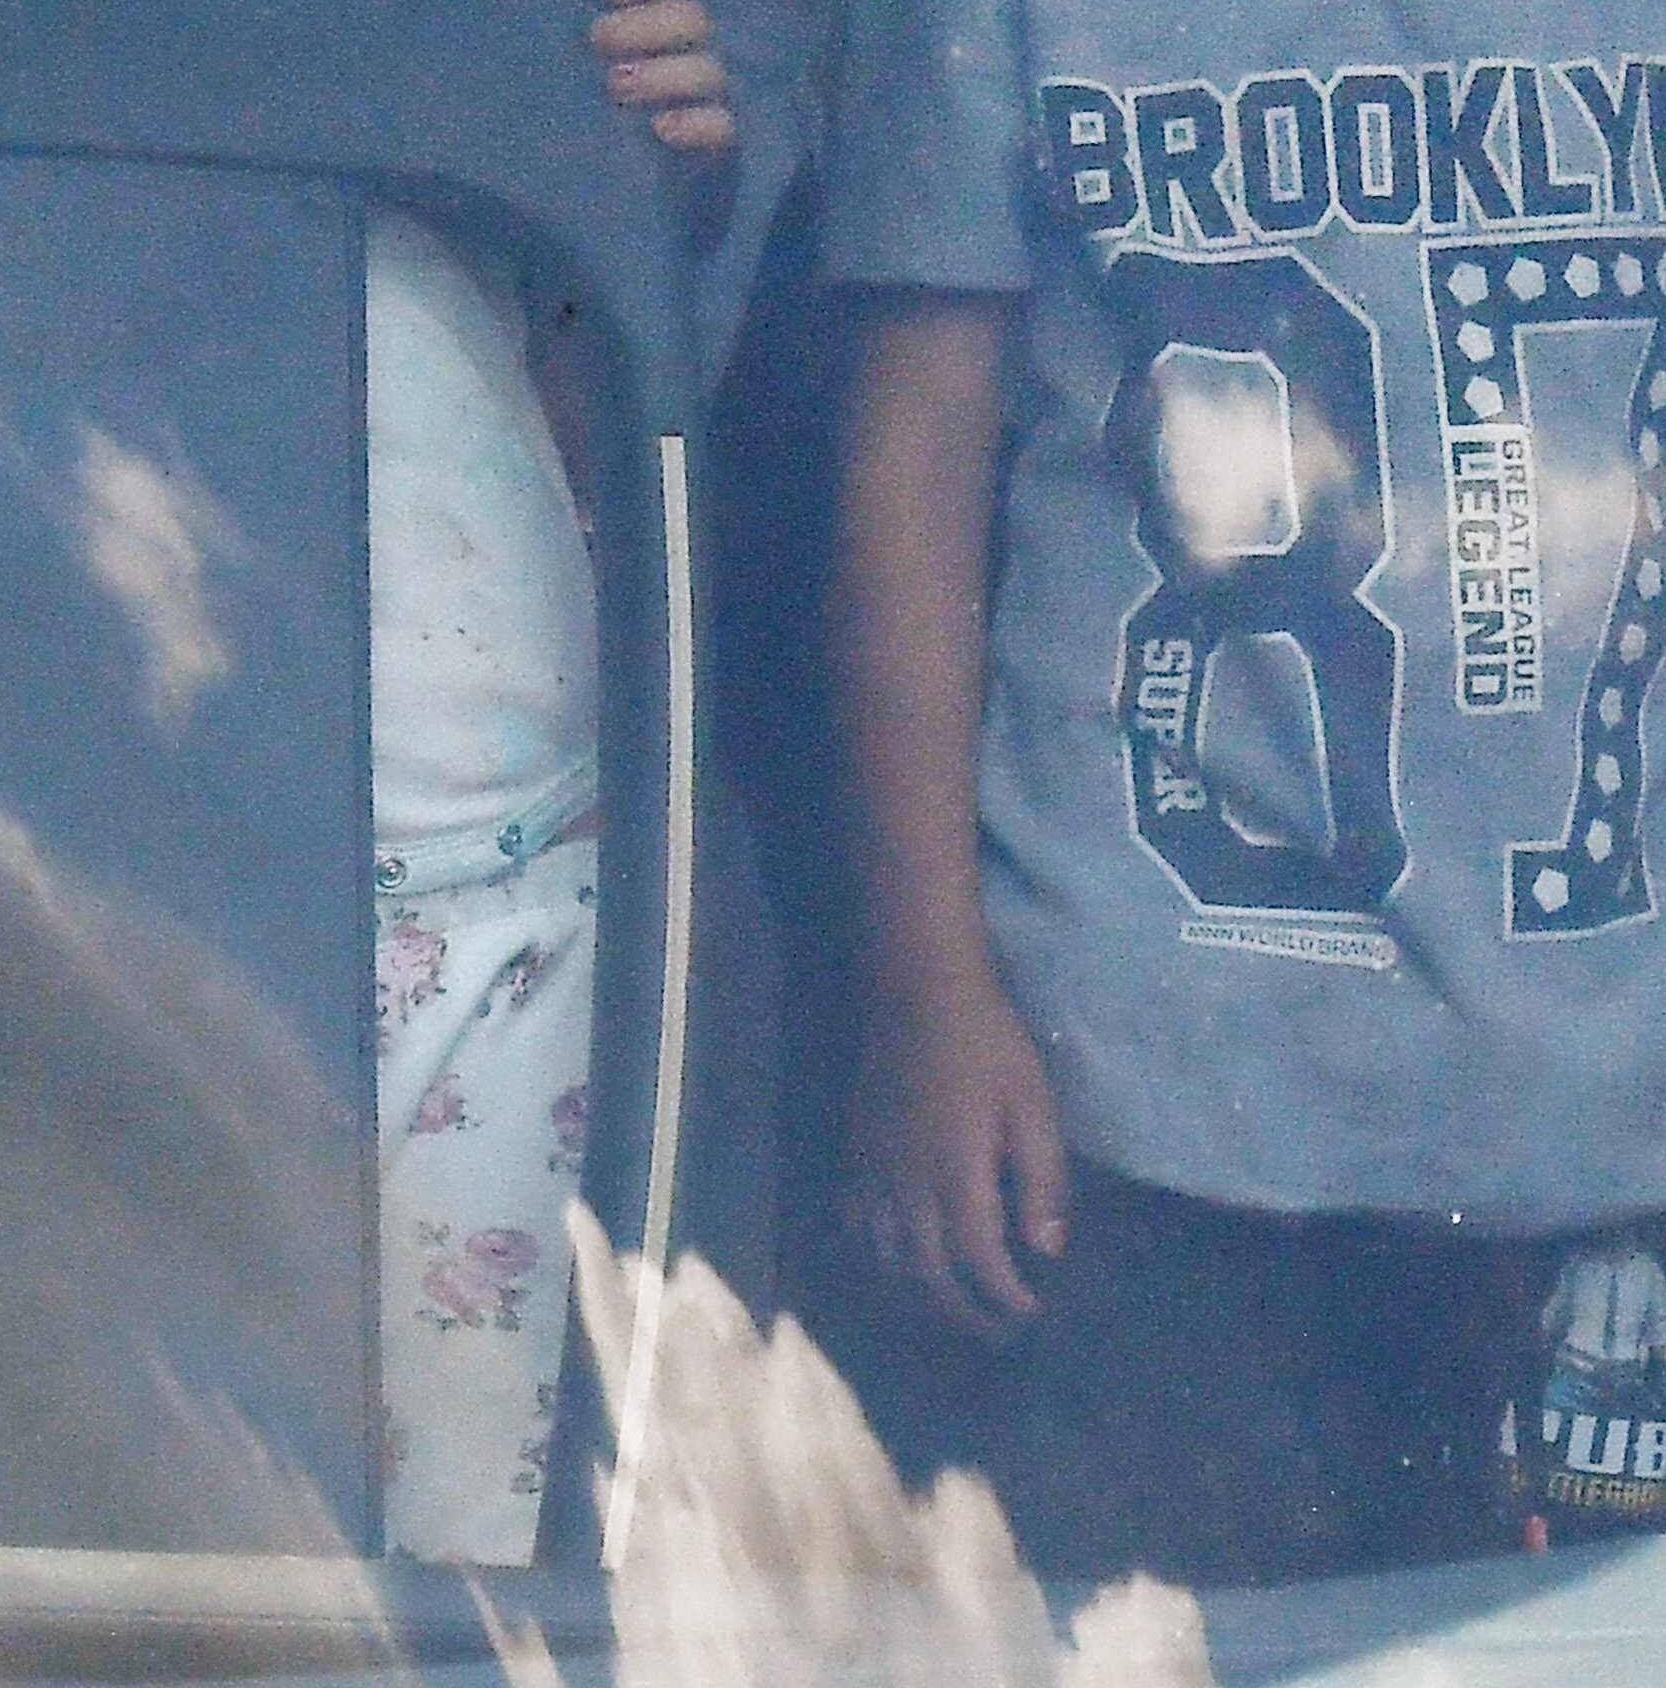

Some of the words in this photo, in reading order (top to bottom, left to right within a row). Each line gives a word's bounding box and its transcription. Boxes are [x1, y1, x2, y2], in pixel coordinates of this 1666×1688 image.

[1451, 440, 1509, 706] LEGEND
[1502, 439, 1530, 552] GREAT
[1507, 566, 1535, 701] LEAGUE
[1137, 639, 1208, 816] SUPR
